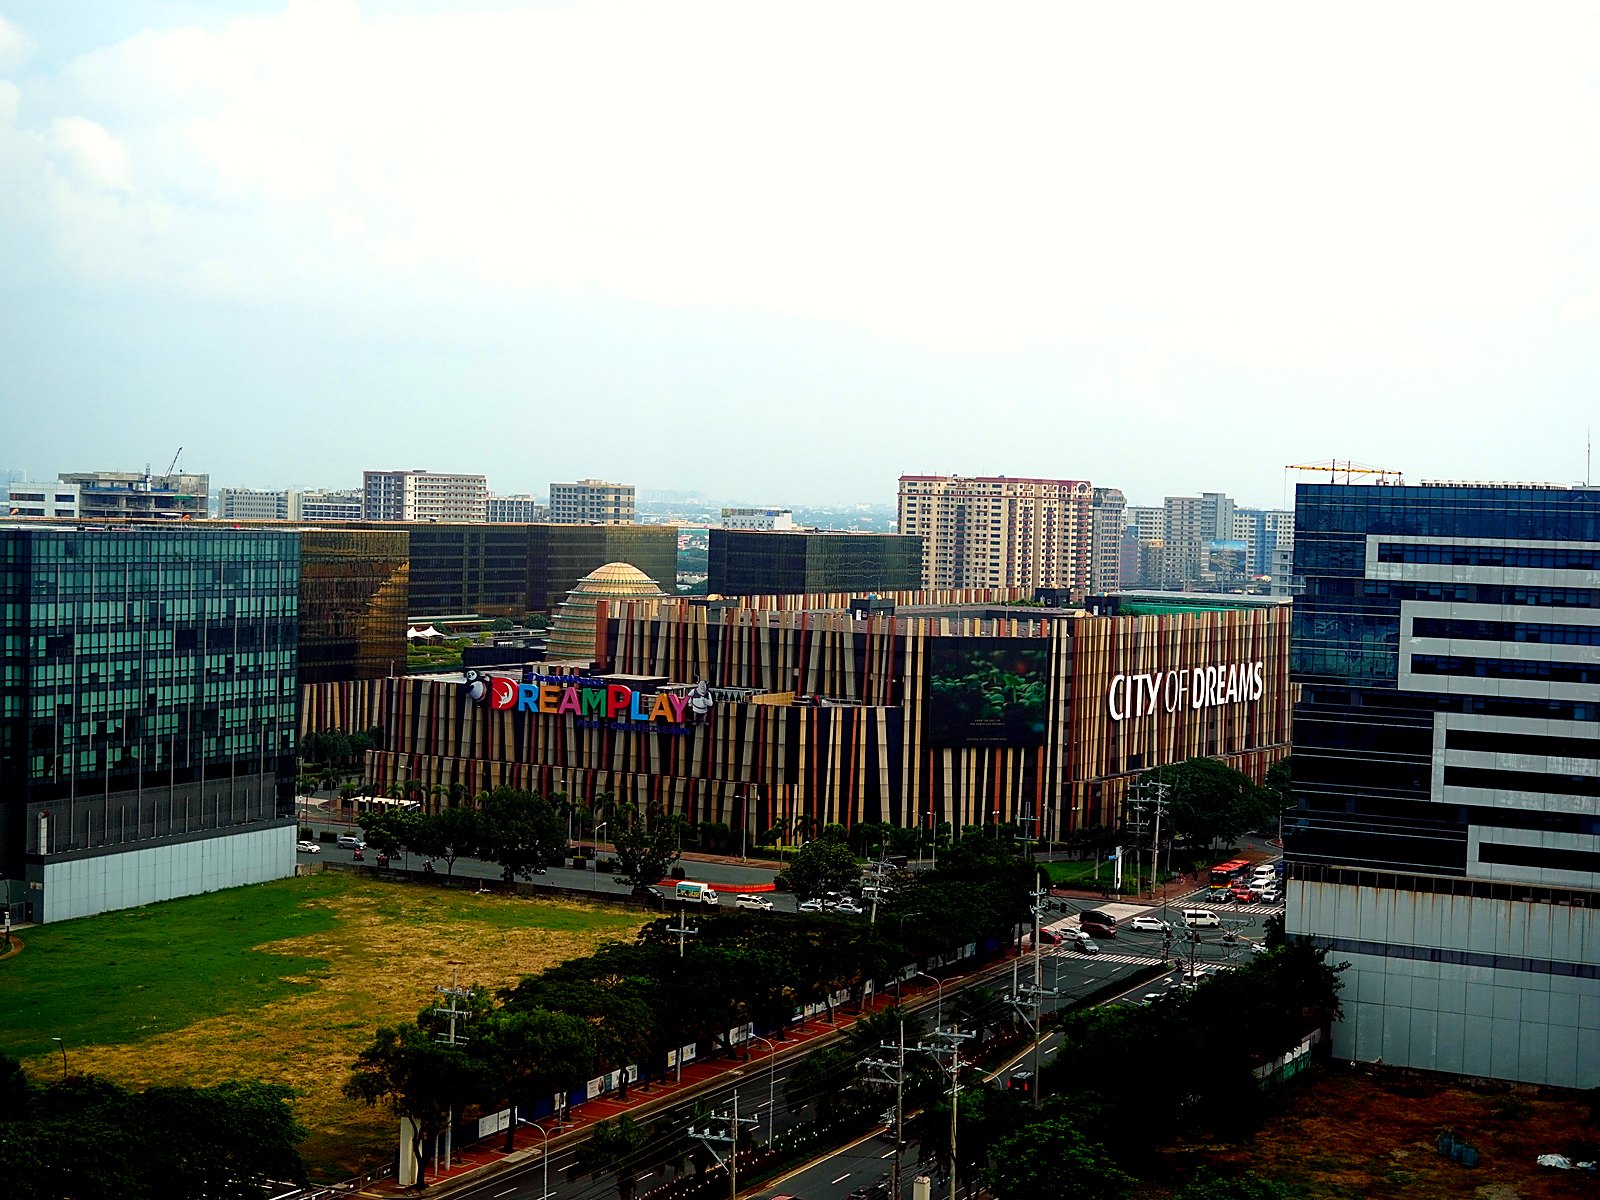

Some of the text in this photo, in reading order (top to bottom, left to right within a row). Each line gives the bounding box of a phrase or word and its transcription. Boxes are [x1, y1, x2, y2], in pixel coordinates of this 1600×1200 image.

[491, 676, 690, 723] DREAMPLAY
[1108, 661, 1263, 721] CITY OF DREAMS
